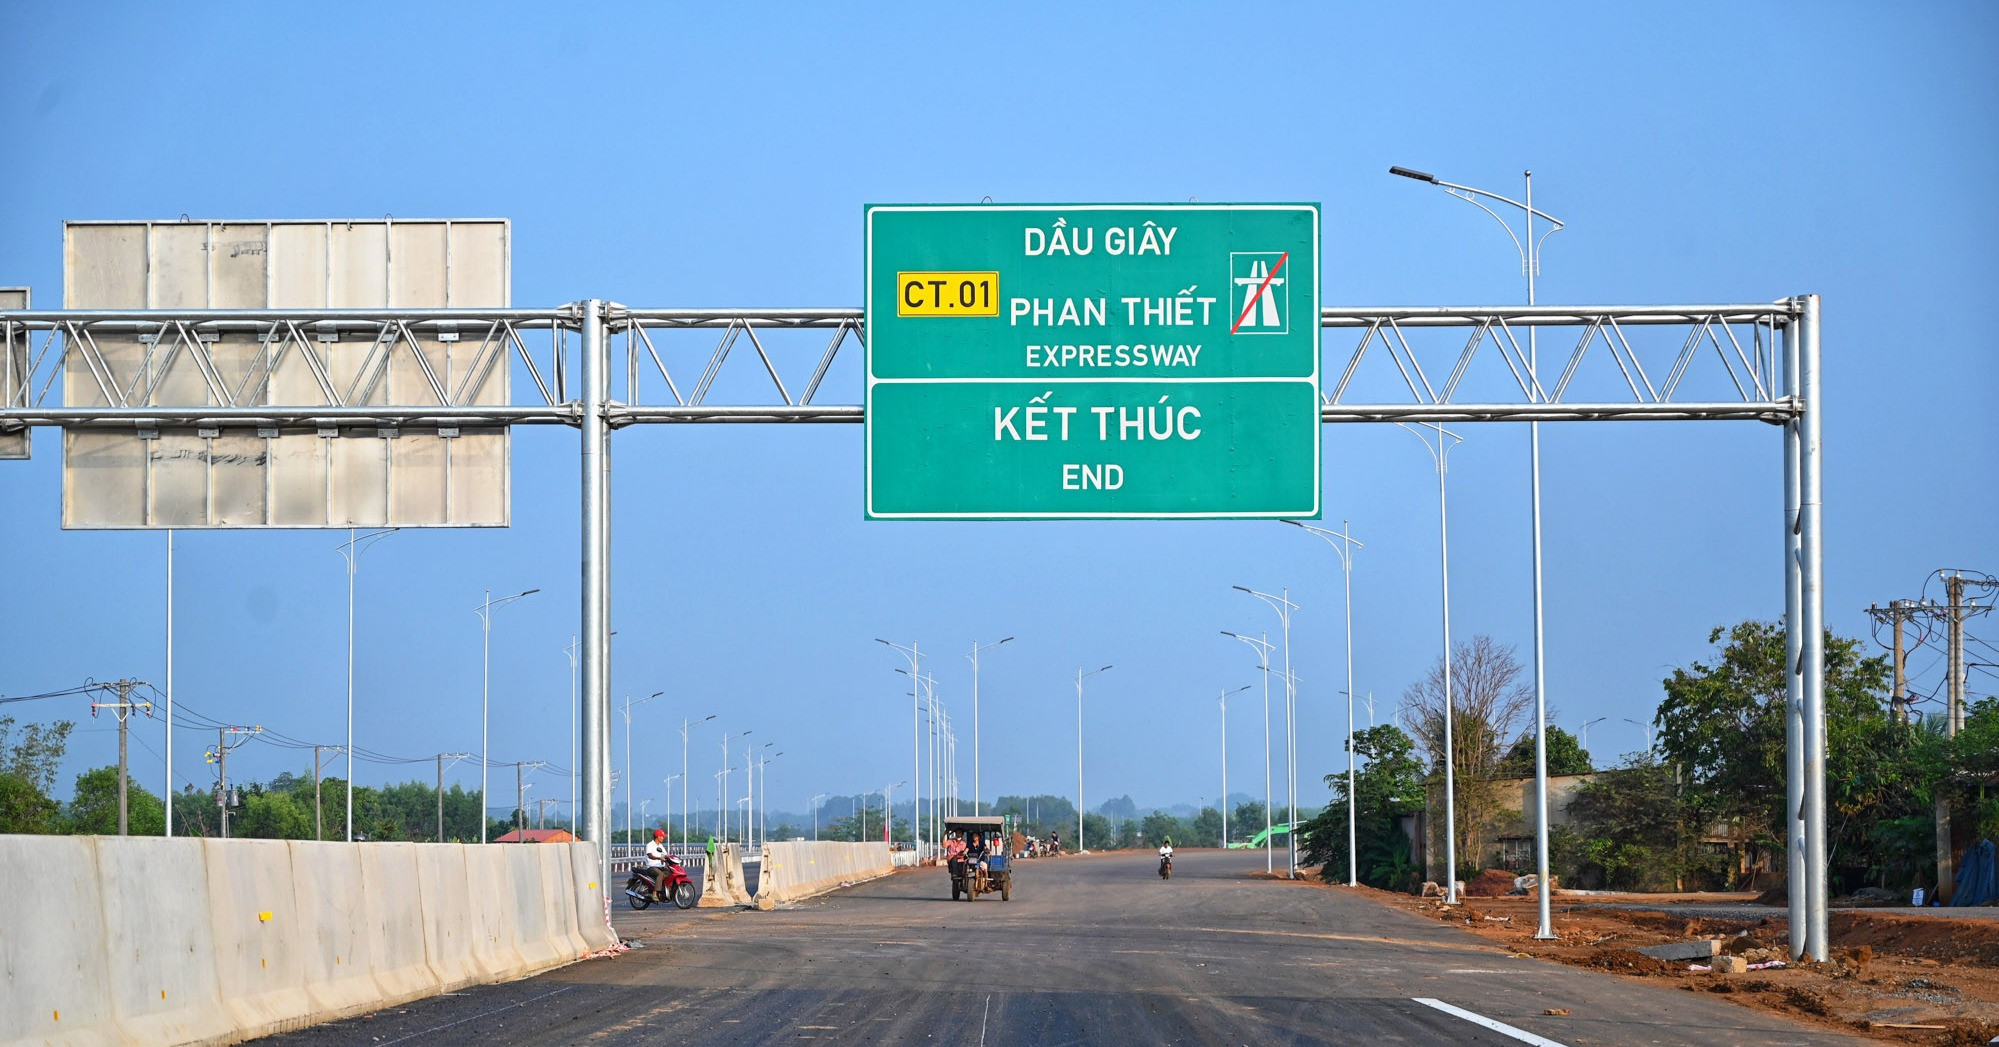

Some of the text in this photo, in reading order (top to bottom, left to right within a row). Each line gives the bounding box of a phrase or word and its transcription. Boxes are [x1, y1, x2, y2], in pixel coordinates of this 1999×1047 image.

[1025, 217, 1178, 256] DẦU GIÂY
[904, 281, 990, 308] CT.01
[1010, 285, 1217, 326] PHAN THIẾT
[1026, 345, 1202, 367] EXPRESSWAY
[994, 391, 1202, 441] KẾT THÚC
[1062, 464, 1124, 490] END
